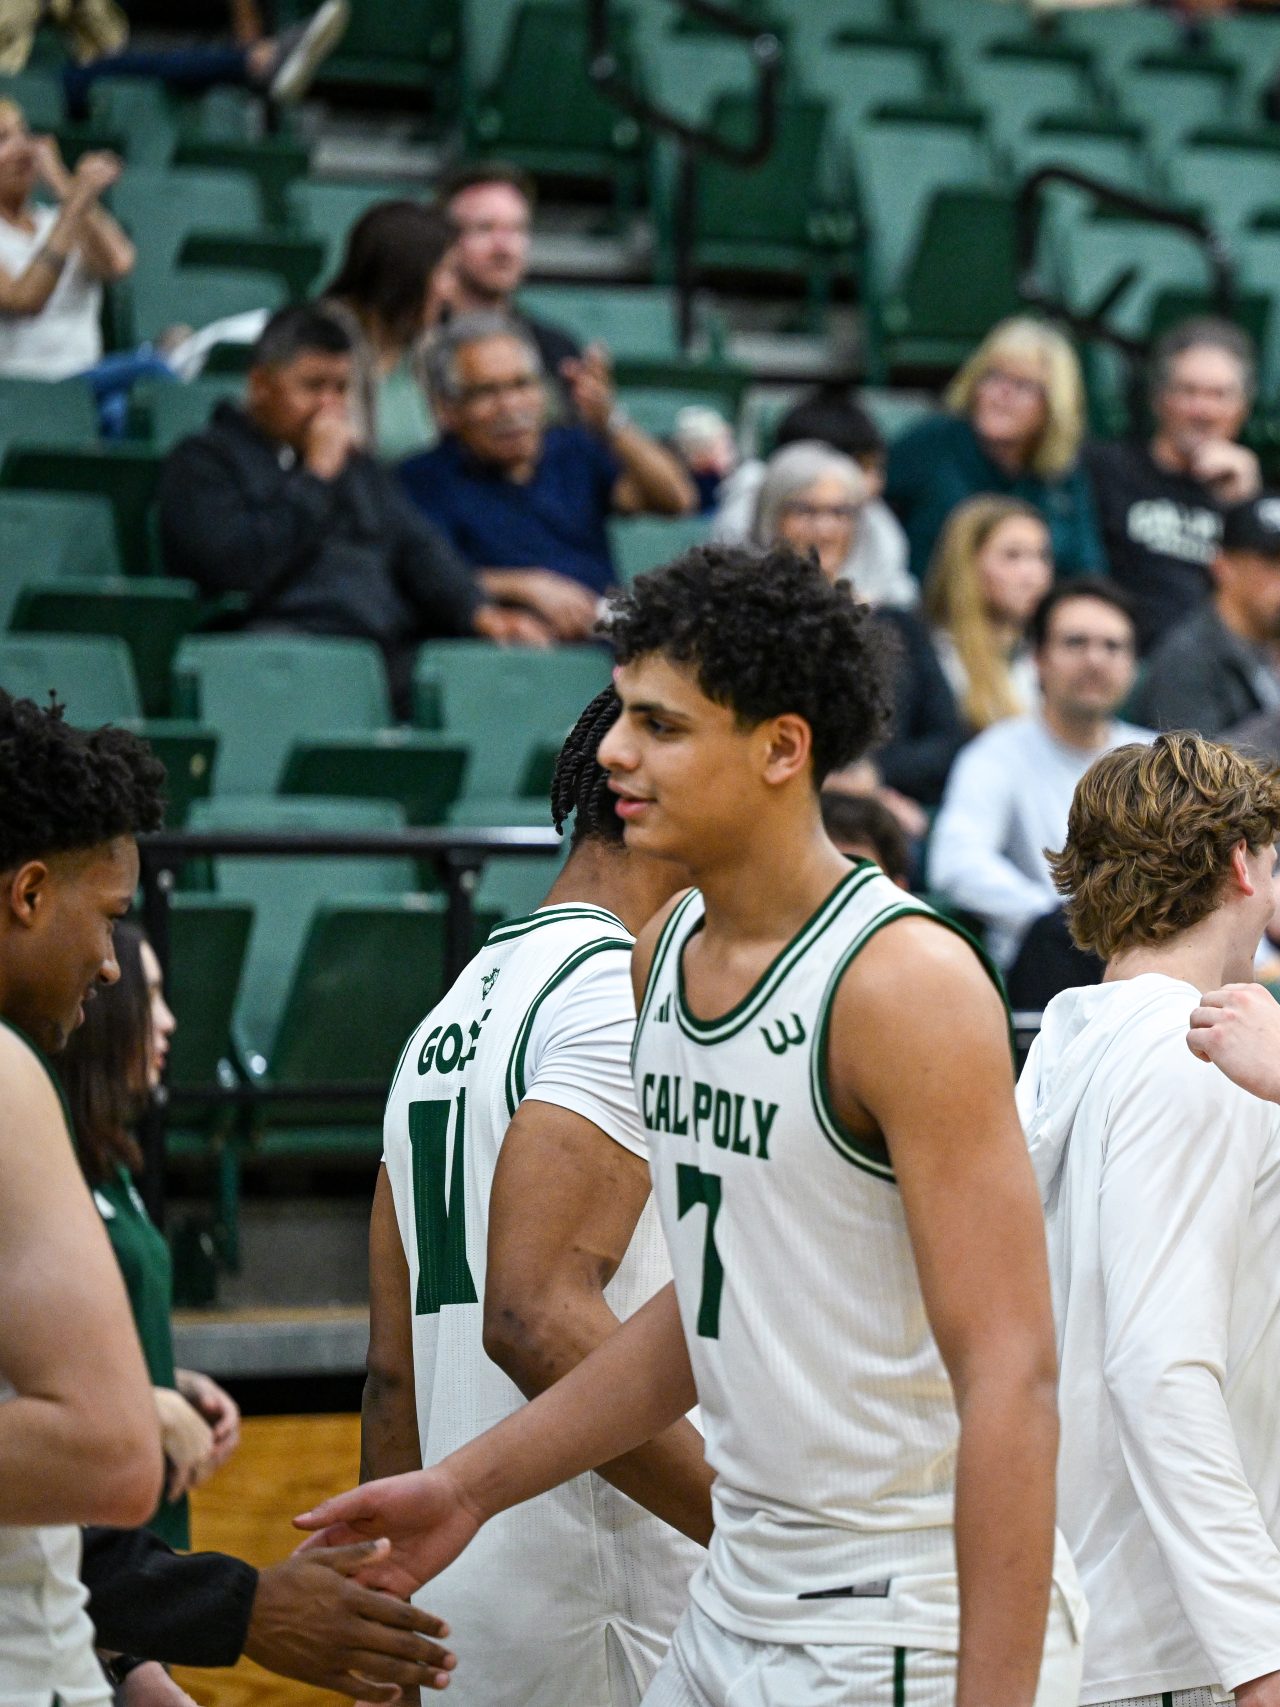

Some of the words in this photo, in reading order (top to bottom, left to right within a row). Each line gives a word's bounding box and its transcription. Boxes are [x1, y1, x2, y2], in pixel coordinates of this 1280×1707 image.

[642, 1073, 688, 1136] CAL
[692, 1080, 780, 1160] POLY
[676, 1162, 724, 1340] 7
